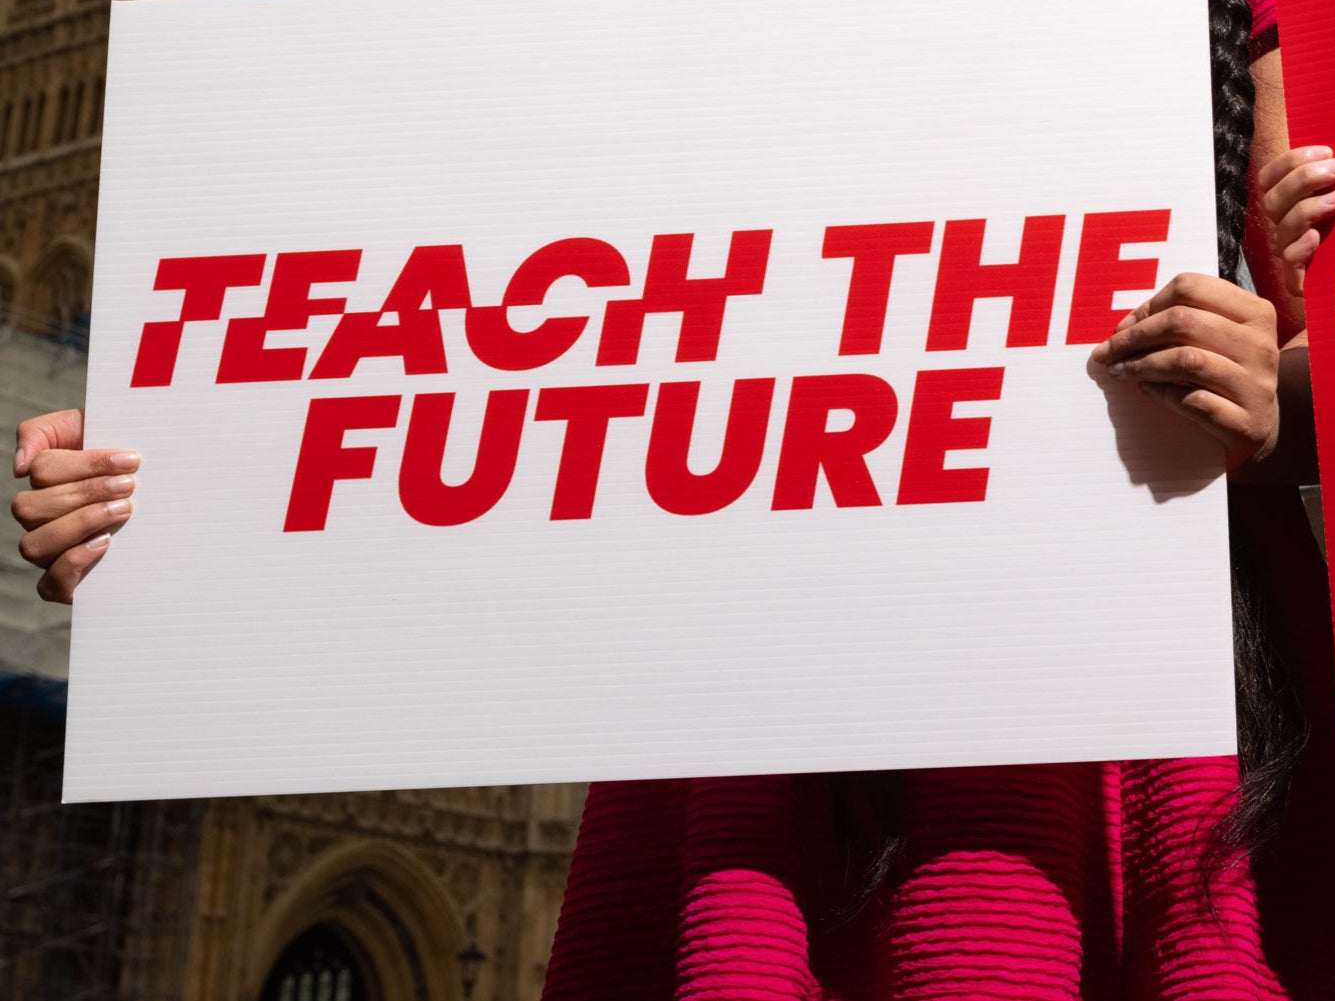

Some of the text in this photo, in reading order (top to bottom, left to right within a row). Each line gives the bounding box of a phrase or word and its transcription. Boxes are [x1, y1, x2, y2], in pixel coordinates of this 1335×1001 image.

[129, 208, 1172, 389] TEACH THE
[282, 366, 1006, 533] FUTURE
